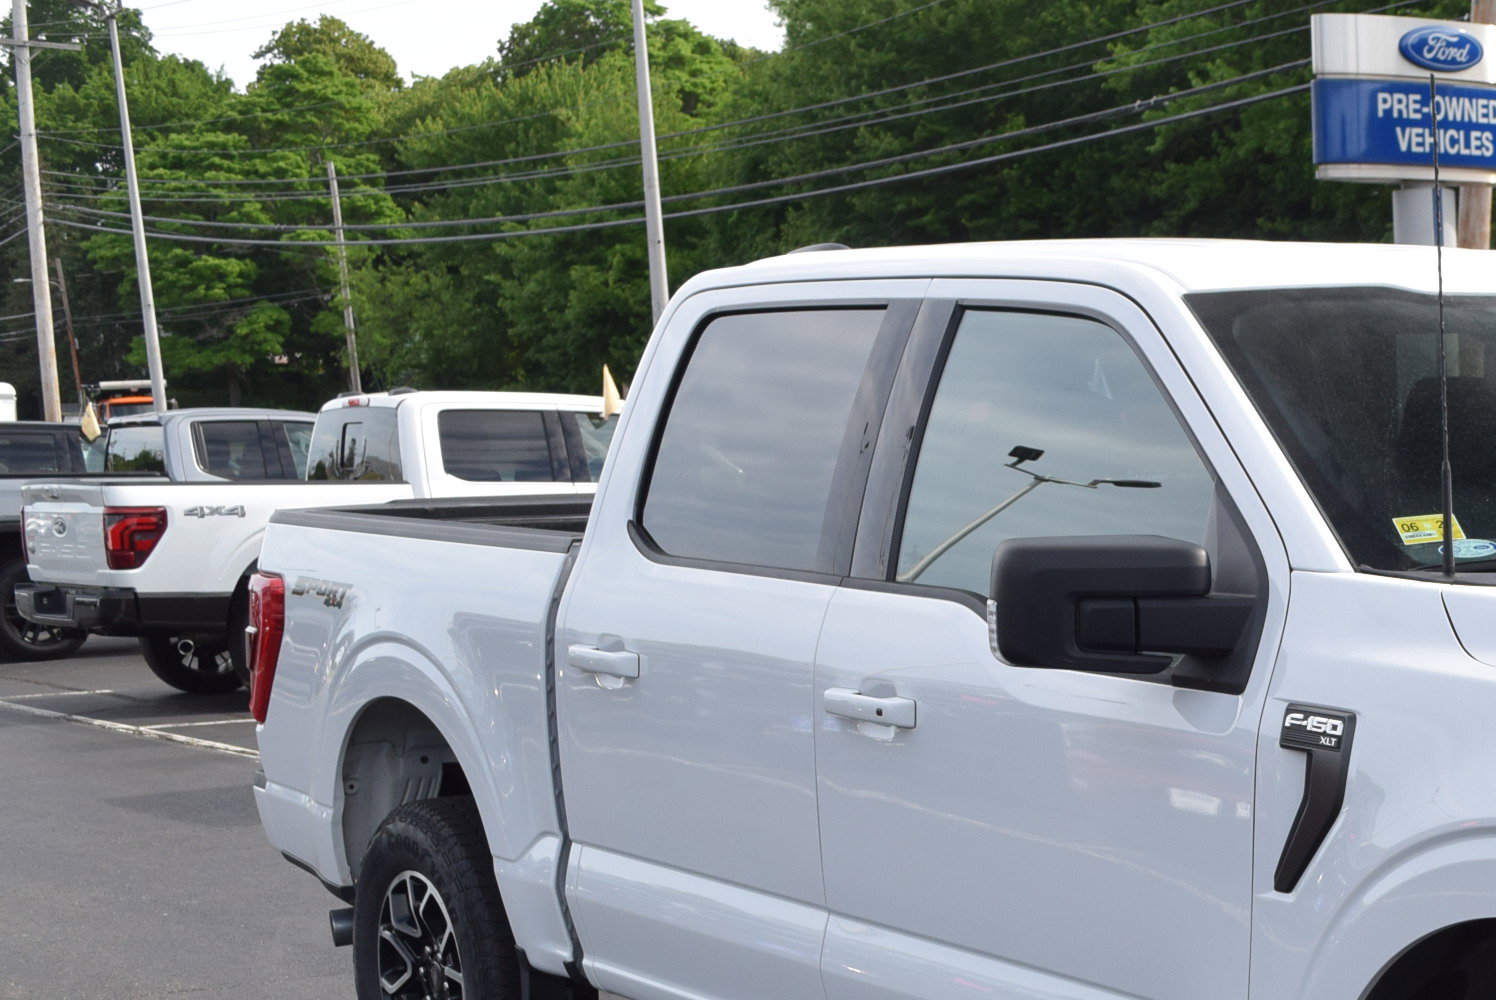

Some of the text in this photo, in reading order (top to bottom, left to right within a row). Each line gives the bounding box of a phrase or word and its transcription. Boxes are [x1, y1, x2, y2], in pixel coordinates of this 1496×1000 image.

[1423, 32, 1471, 63] Ford
[1395, 127, 1494, 157] VEHICLES
[1401, 522, 1419, 532] 06
[291, 575, 353, 599] SPORT
[1284, 713, 1344, 736] F-150
[1319, 735, 1337, 747] XLT
